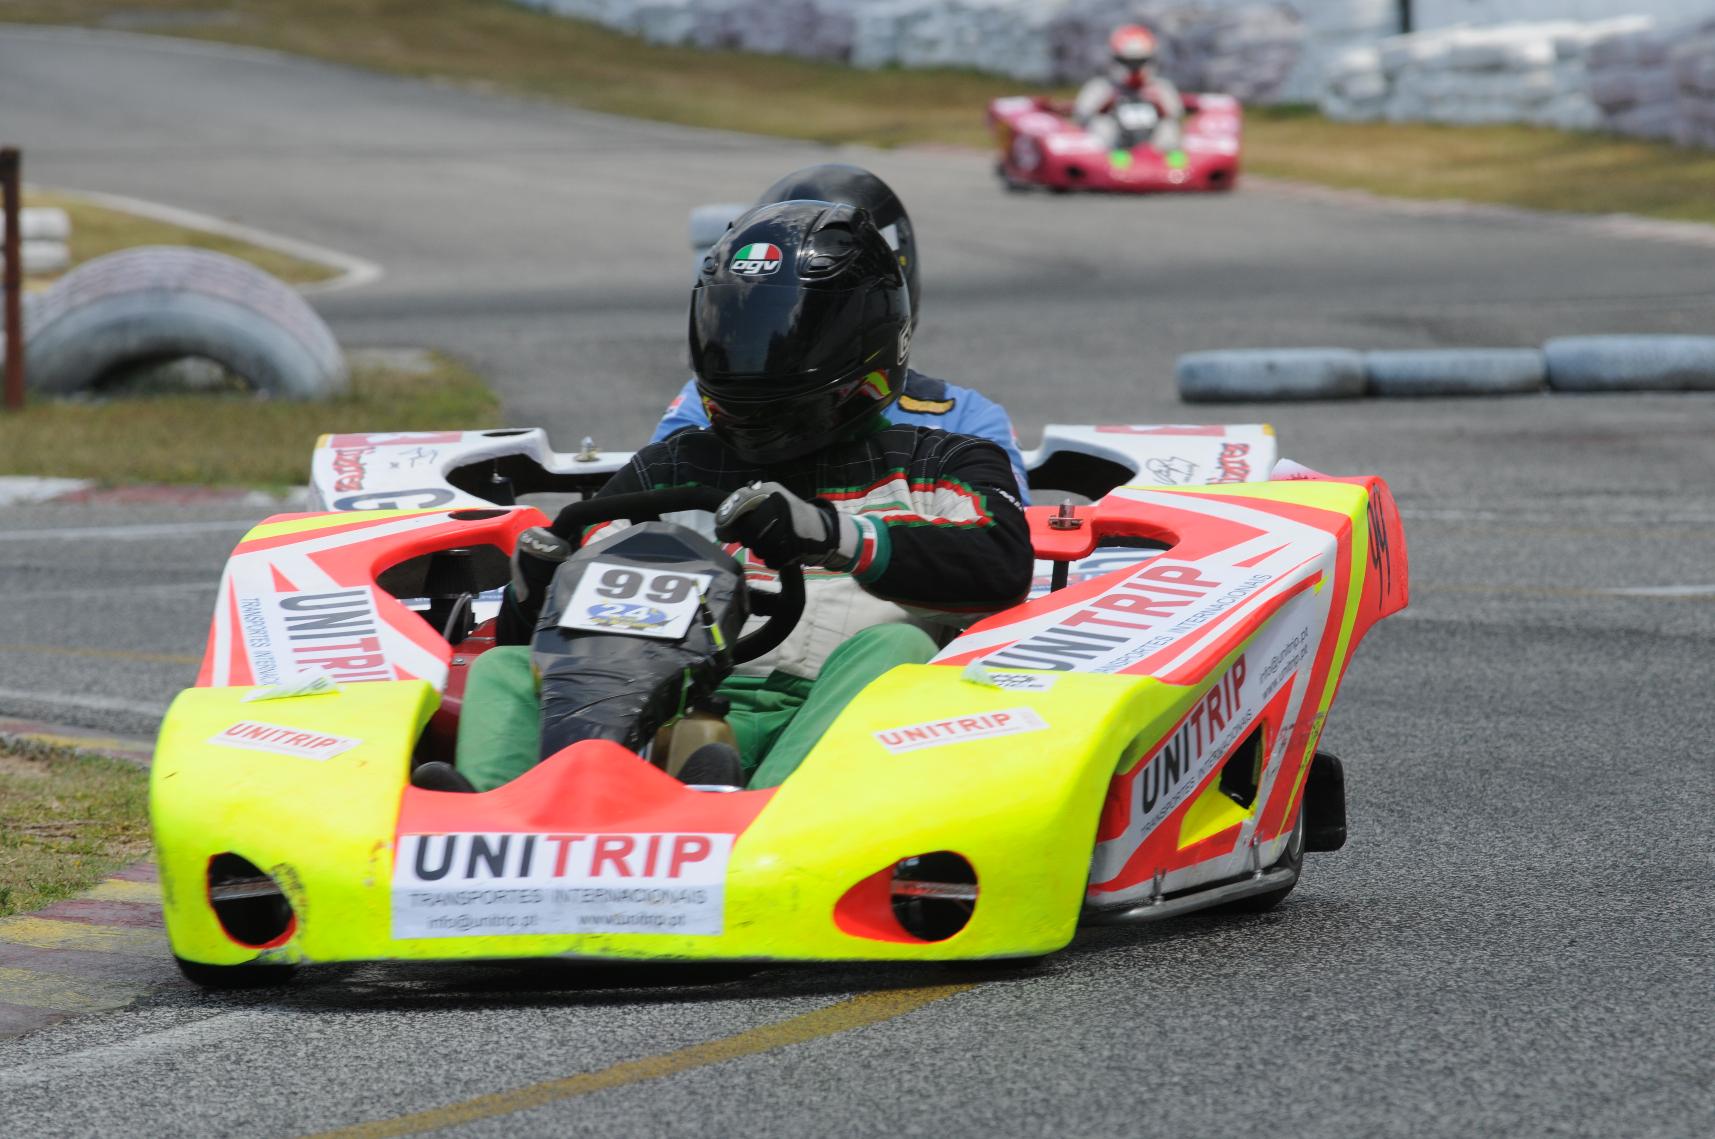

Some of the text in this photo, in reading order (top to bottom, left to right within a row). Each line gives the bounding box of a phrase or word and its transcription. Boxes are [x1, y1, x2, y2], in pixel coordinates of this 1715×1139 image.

[731, 260, 779, 274] agv
[595, 568, 693, 604] 99
[1168, 573, 1273, 635] INTERNACIONAIS
[278, 589, 392, 683] UNITRI
[981, 565, 1222, 672] UNITRIP
[224, 722, 338, 750] UNITRIP
[879, 712, 1012, 746] UNITRIP
[1142, 652, 1247, 815] UNITRIP
[414, 834, 713, 881] UNITRIP
[408, 887, 708, 908] TRANSPORTES INTERNACIONAIS
